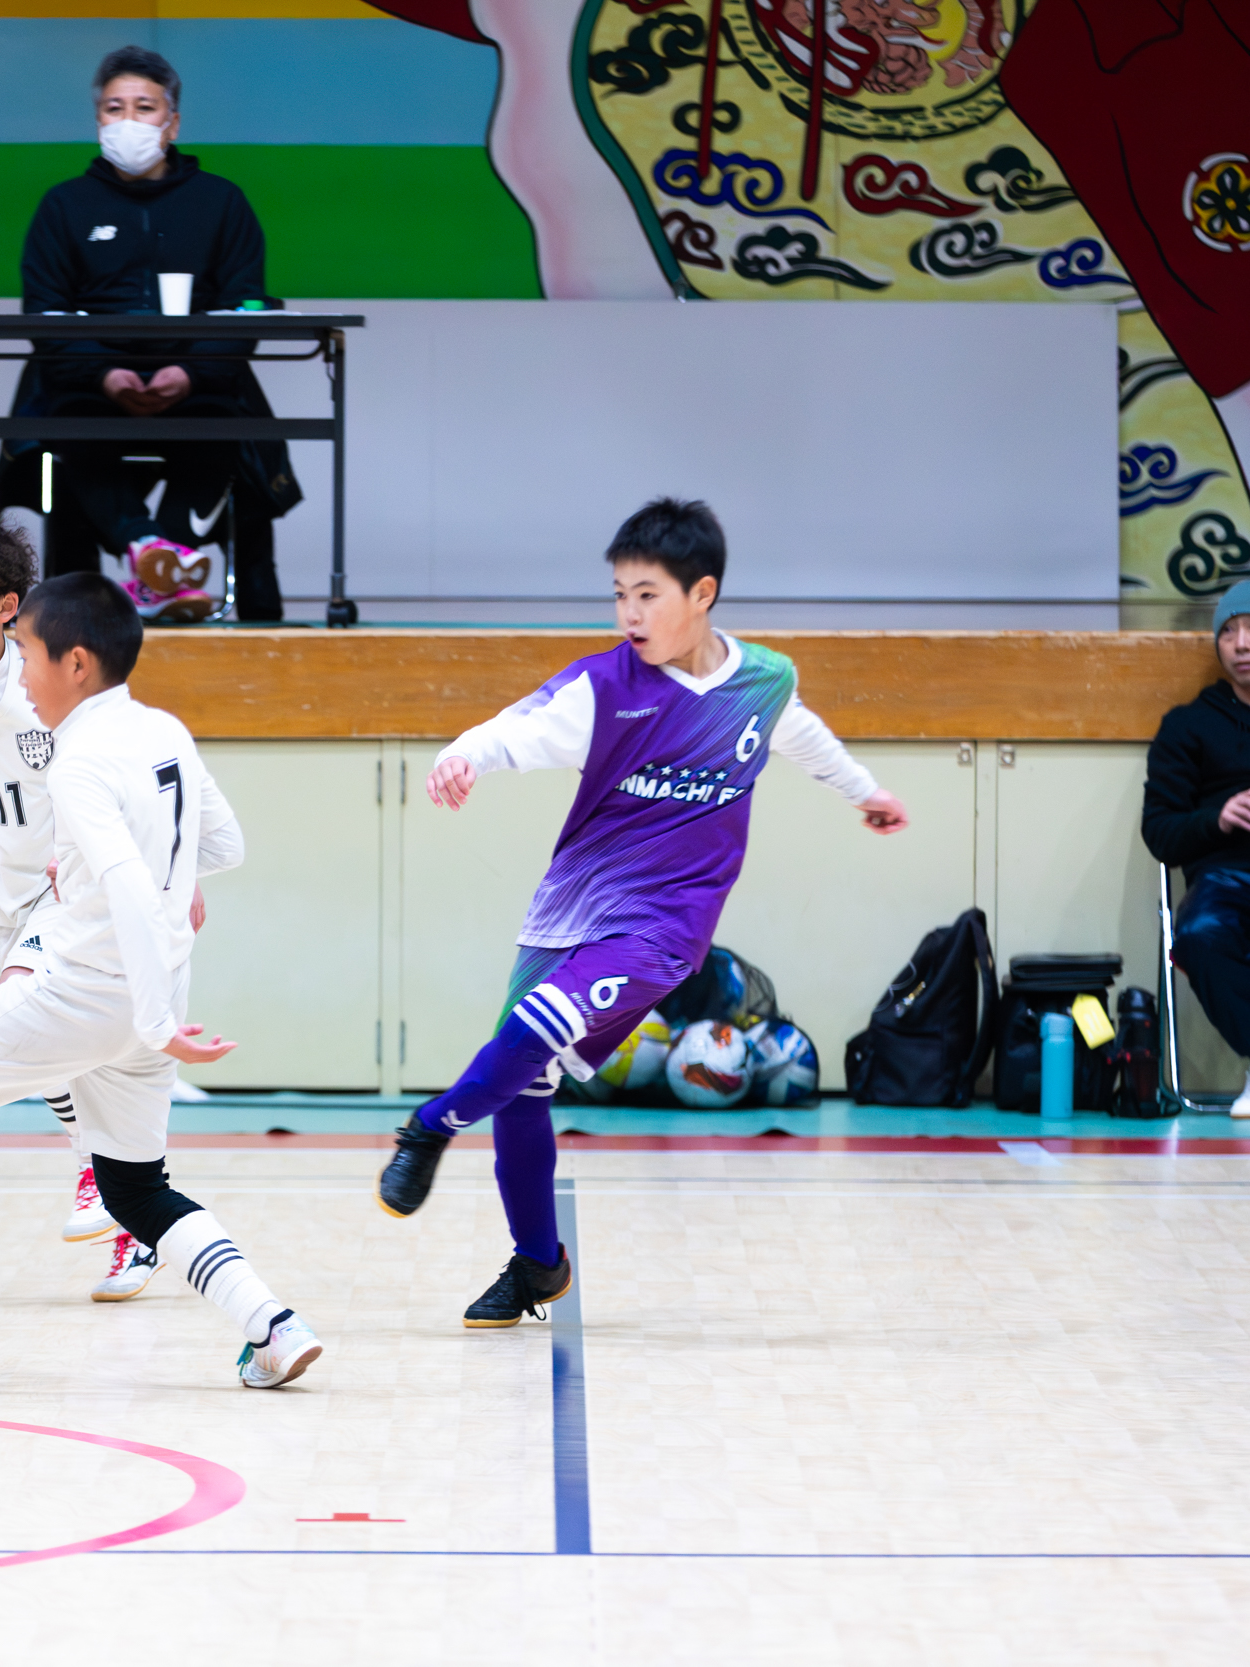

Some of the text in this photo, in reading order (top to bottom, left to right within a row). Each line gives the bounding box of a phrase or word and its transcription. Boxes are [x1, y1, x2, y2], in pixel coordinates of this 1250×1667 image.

[735, 714, 761, 763] 6
[615, 774, 715, 803] NMACHI
[152, 757, 186, 891] 7
[589, 975, 629, 1011] 6
